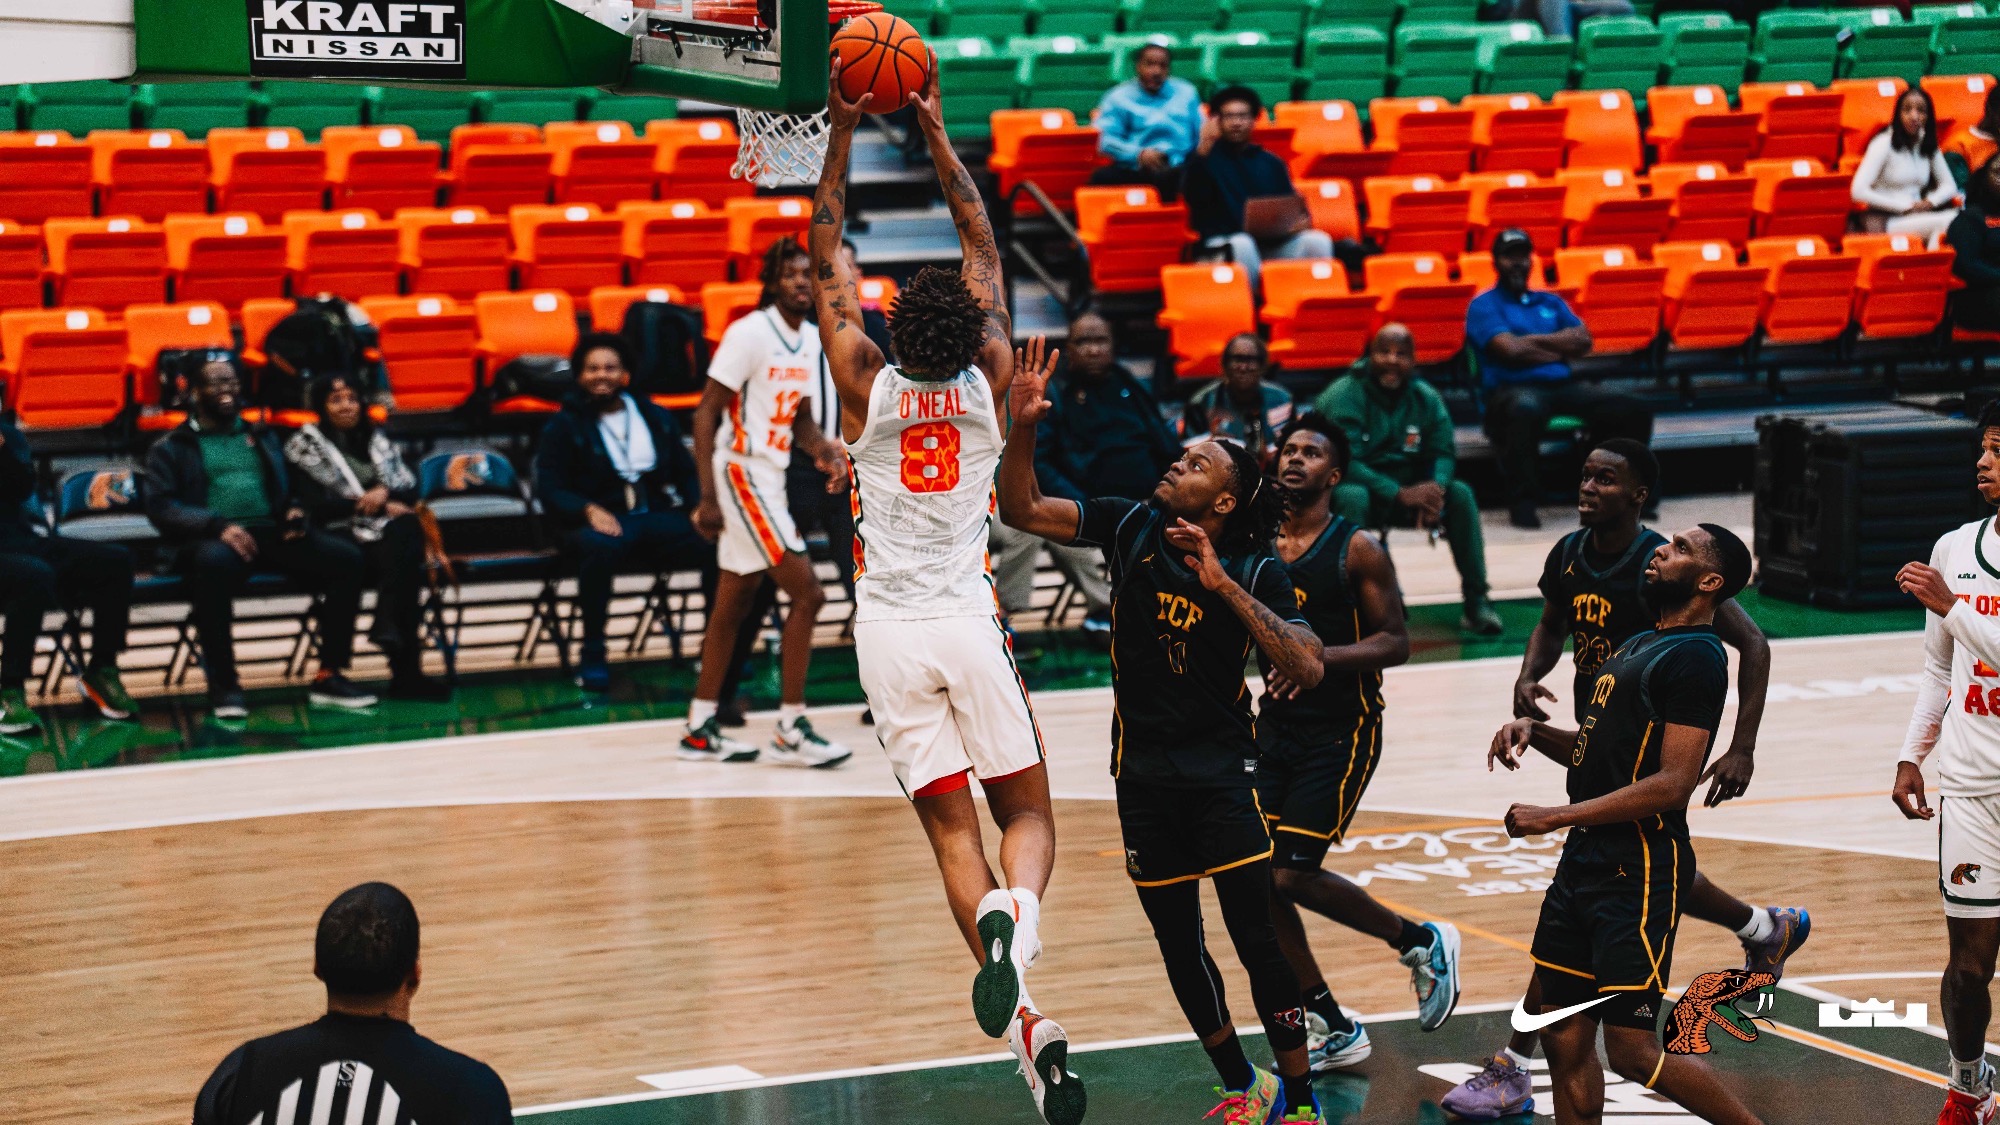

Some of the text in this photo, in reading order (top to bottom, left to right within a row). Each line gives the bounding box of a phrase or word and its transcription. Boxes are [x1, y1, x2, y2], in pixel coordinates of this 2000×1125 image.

[262, 0, 455, 34] KRAFT
[272, 38, 444, 58] NISSAN
[899, 387, 968, 419] O'NEAL
[900, 420, 961, 494] 8
[1156, 591, 1204, 633] TCF
[1572, 593, 1612, 628] TCF
[1574, 631, 1612, 675] 23
[1590, 673, 1616, 709] TCF
[1572, 715, 1597, 767] 5
